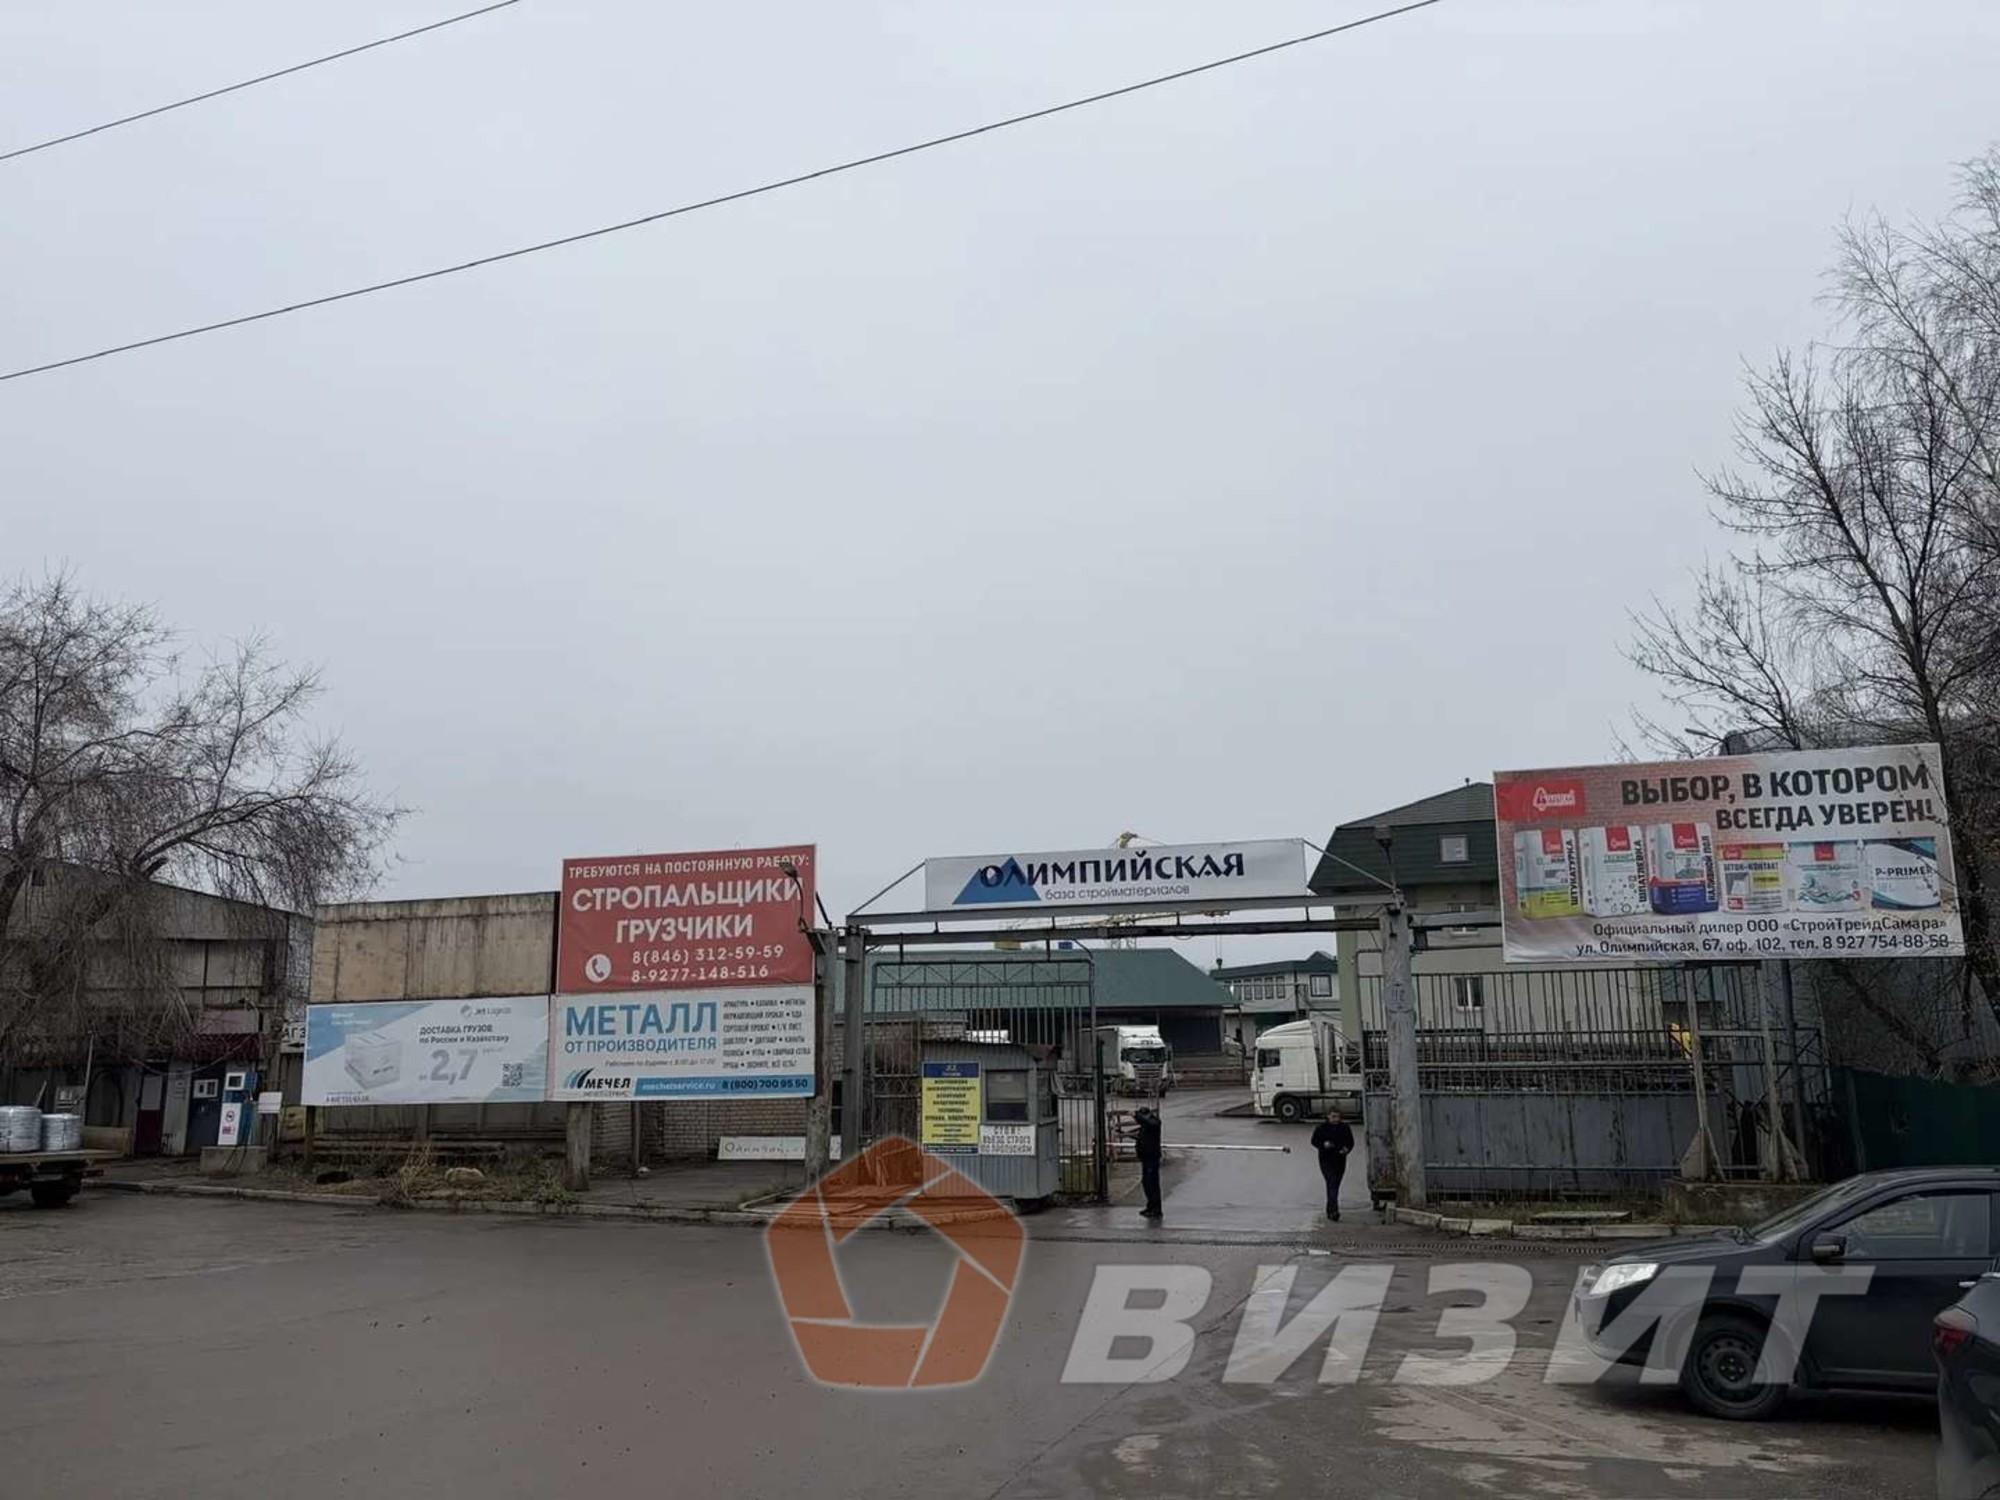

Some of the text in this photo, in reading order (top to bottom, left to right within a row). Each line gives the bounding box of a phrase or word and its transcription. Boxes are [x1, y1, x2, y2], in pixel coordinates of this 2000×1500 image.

[1621, 763, 1930, 805] ВЫБОР, В КОТОРОМ
[1716, 799, 1934, 831] ВСЕГДА УВЕРЕН!
[569, 863, 640, 879] ТРЕБУЮТСЯ
[645, 862, 662, 875] НА
[665, 858, 753, 874] ПОСТОЯННУЮ
[979, 850, 1245, 888] ОЛИМПИЙСКАЯ
[1566, 839, 1579, 906] ШТУКАТУРКА
[571, 877, 804, 912] СТРОПАЛЬЩИКИ
[1045, 884, 1190, 901] база стройматериалов
[616, 914, 753, 944] ГРУЗЧИКИ
[1593, 921, 1695, 940] Официальный
[1698, 922, 1743, 936] дилер
[632, 944, 785, 967] 8(846) 312-59-59
[1576, 944, 1597, 956] ул.
[1726, 938, 1751, 953] оф.
[1789, 938, 1819, 950] тел.
[631, 965, 769, 983] 8-9277-148-516
[419, 1024, 494, 1036] ДОСТАВКА ГРУЗОВ
[565, 1001, 717, 1037] МЕТАЛЛ
[564, 1040, 585, 1054] ОТ
[586, 1037, 717, 1054] ПРОИЗВОДИТЕЛЯ
[431, 1048, 479, 1085] 2,7
[585, 1077, 632, 1090] МЕЧЕЛ
